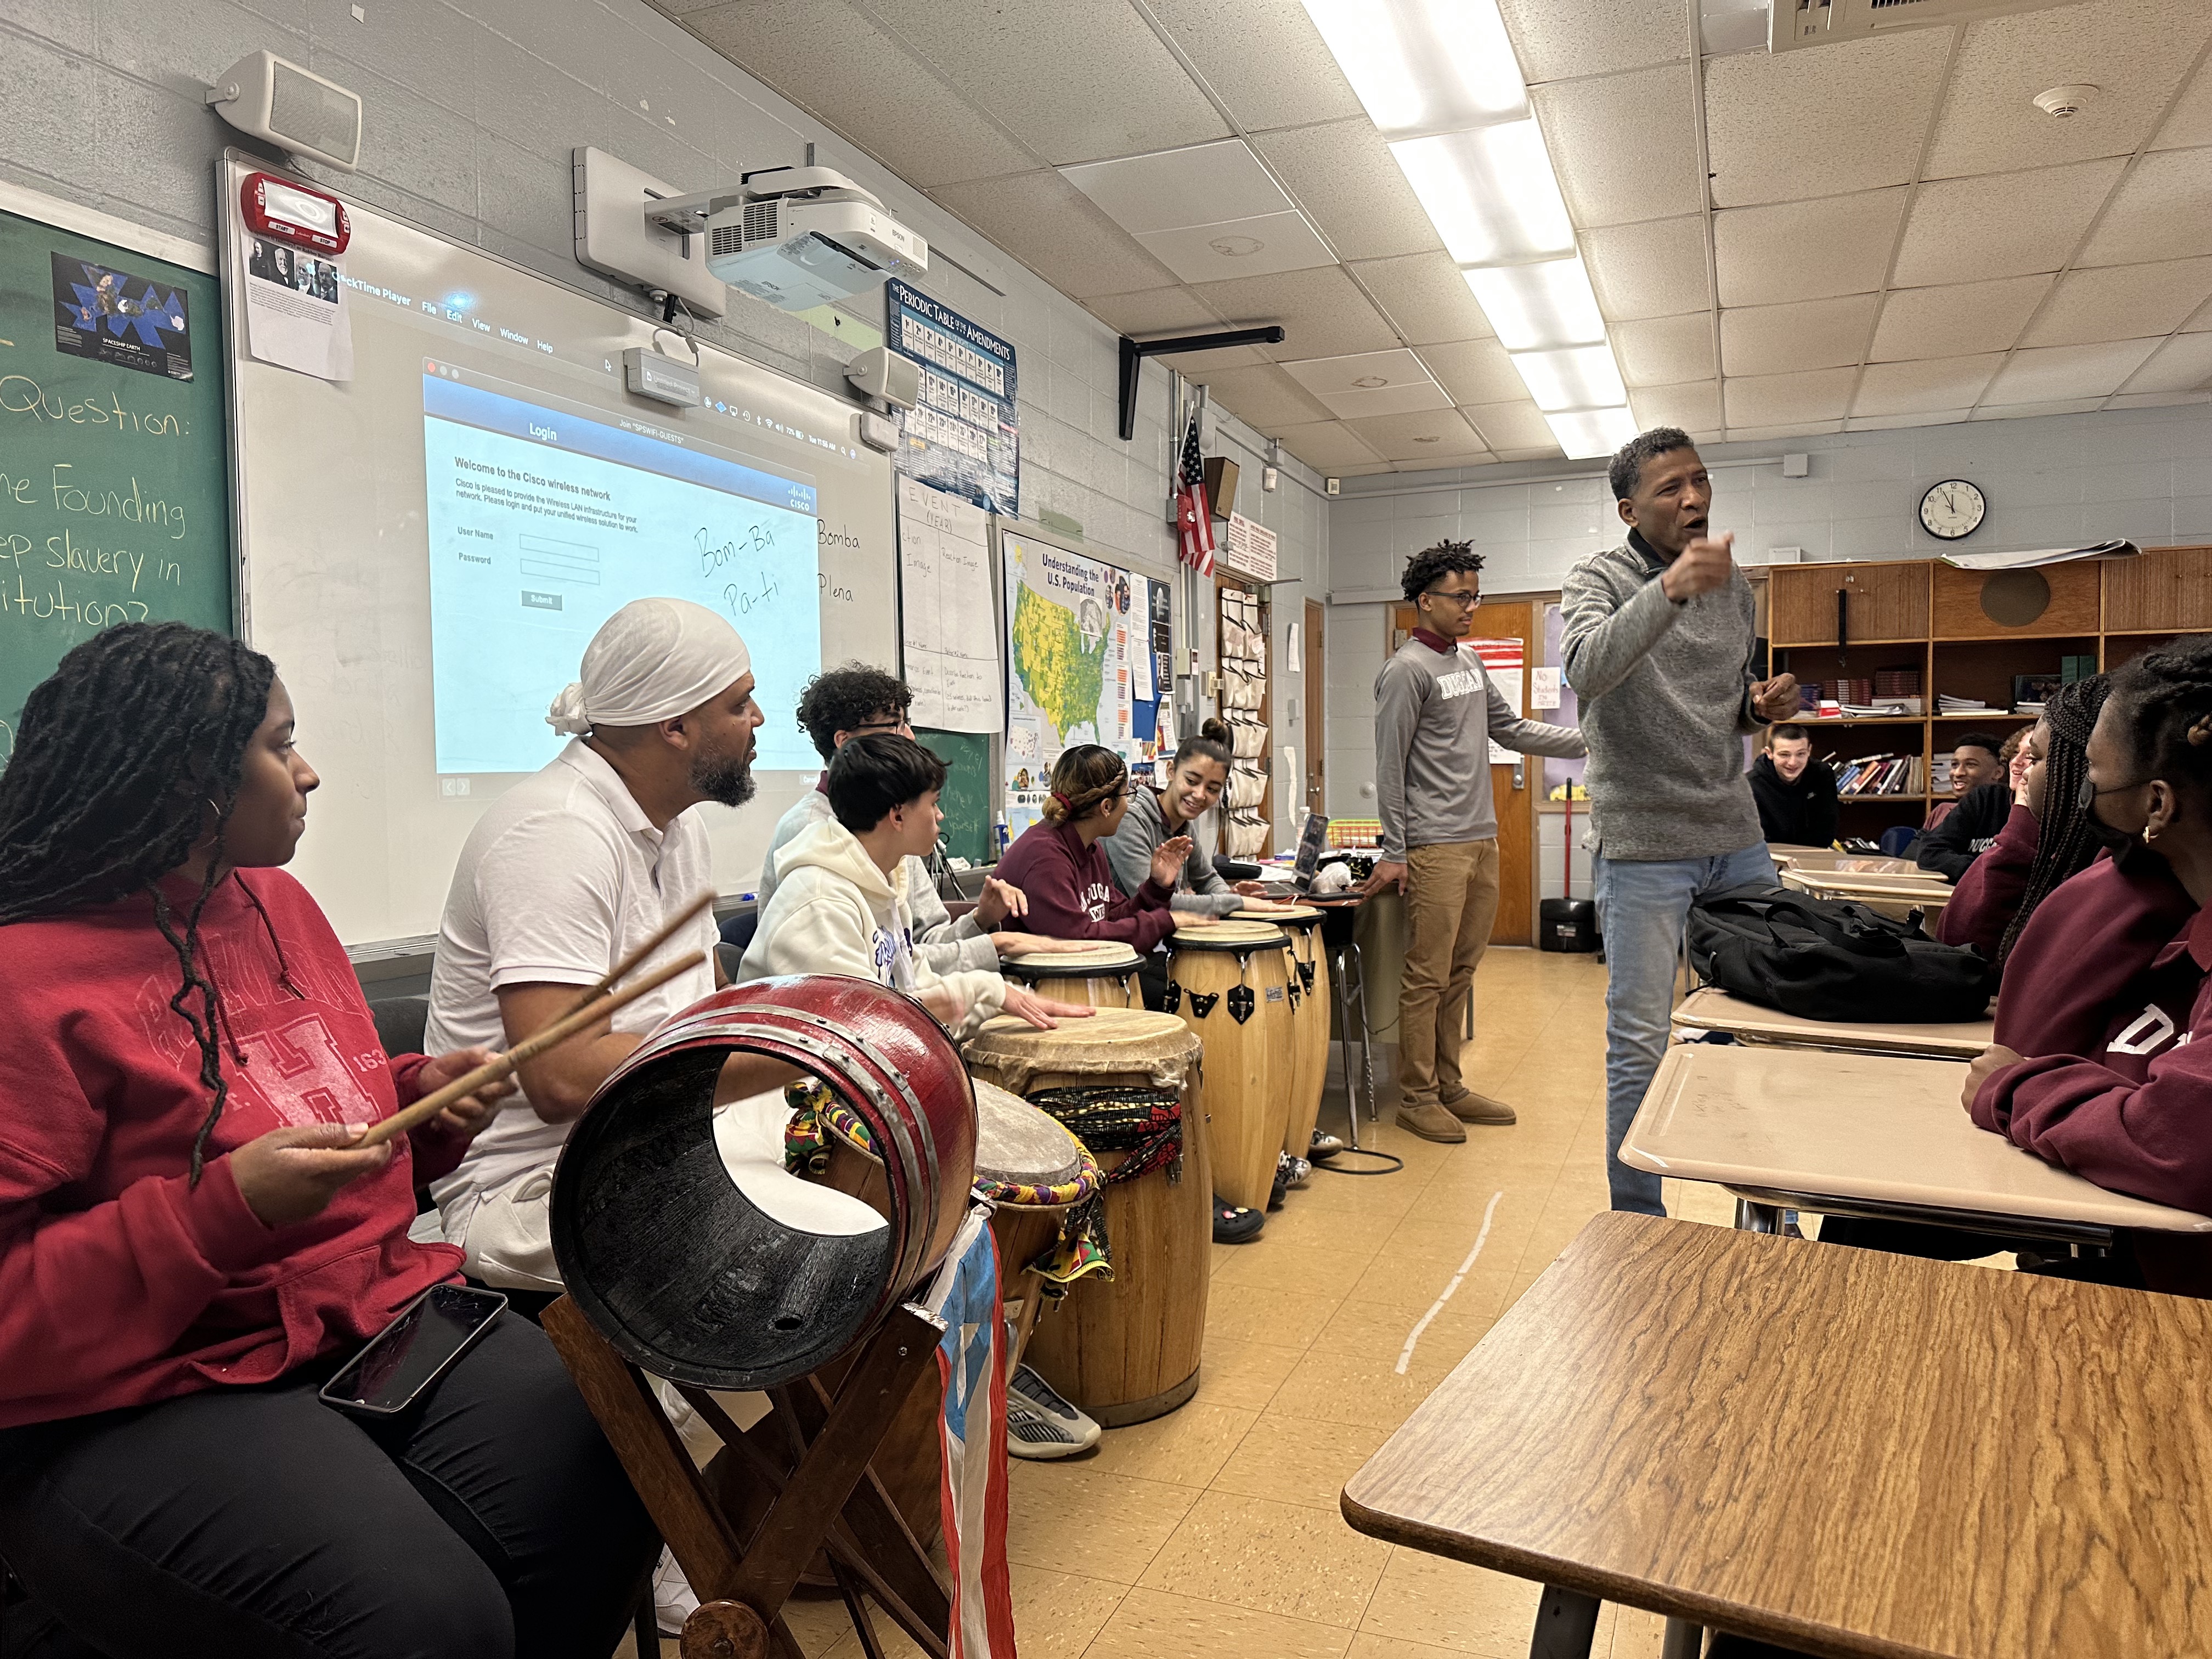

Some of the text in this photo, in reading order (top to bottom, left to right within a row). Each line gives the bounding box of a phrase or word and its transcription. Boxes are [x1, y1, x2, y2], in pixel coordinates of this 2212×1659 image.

[382, 287, 411, 306] Player
[422, 301, 436, 315] File
[447, 309, 462, 324] Edit
[472, 318, 490, 332] View
[500, 328, 529, 345] Window
[537, 340, 553, 354] Help
[900, 285, 933, 317] PERIODIC
[933, 304, 955, 330] TABLE
[955, 319, 960, 328] OF
[967, 325, 1010, 360] AMENDMENTS
[103, 337, 126, 347] SPACESHIP
[126, 342, 140, 351] EARTH
[0, 375, 190, 437] Question:
[529, 422, 557, 441] Login
[619, 419, 631, 429] Join
[786, 427, 795, 436] 72%
[809, 435, 817, 445] Tue
[828, 443, 836, 451] AM
[454, 456, 611, 501] Welcome to the Cisco wireless network
[52, 464, 185, 539] Founding
[456, 478, 473, 489] Cisco
[475, 482, 481, 490] is
[482, 484, 505, 496] pleased
[506, 489, 512, 498] to
[514, 492, 535, 502] provide
[536, 495, 545, 504] the
[546, 498, 570, 510] Wireless
[571, 503, 583, 512] LAN
[584, 505, 617, 520] infrastructure
[626, 516, 637, 524] your
[456, 490, 482, 501] network.
[484, 494, 504, 506] Please
[506, 499, 520, 510] login
[521, 503, 532, 511] and
[533, 506, 543, 514] put
[544, 508, 556, 516] your
[557, 511, 575, 521] unified
[576, 515, 597, 525] wireless
[599, 519, 618, 529] solution
[625, 525, 639, 533] work.
[790, 499, 810, 511] CISCO
[909, 487, 961, 517] EVENT
[458, 526, 494, 540] User Name
[817, 519, 860, 549] Bomba
[927, 510, 952, 534] (YEAR)
[159, 549, 180, 586] in
[458, 552, 491, 565] Password
[907, 554, 932, 577] Image
[1042, 553, 1099, 582] Understanding the
[817, 573, 854, 602] Plena
[1048, 572, 1094, 597] U.S. Population
[531, 594, 553, 605] Submit
[1536, 670, 1547, 681] No
